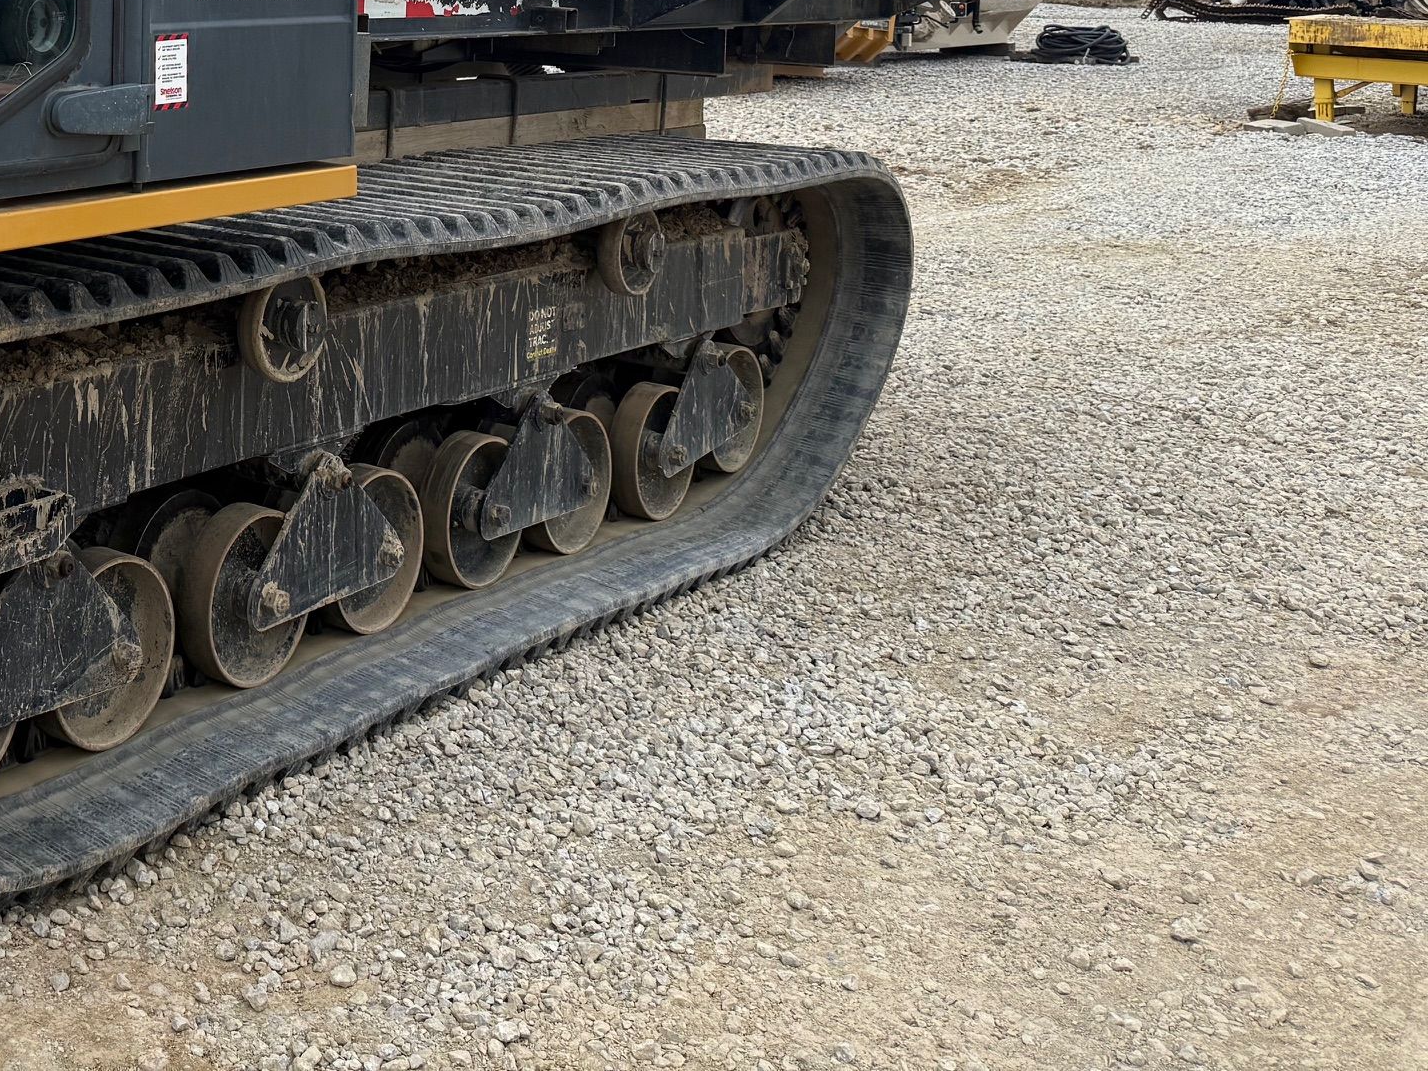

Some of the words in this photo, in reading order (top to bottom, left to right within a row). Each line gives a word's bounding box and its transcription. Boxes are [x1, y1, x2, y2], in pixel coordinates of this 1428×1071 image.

[528, 309, 540, 321] DO
[540, 306, 557, 319] NOT
[528, 334, 556, 348] TRAC
